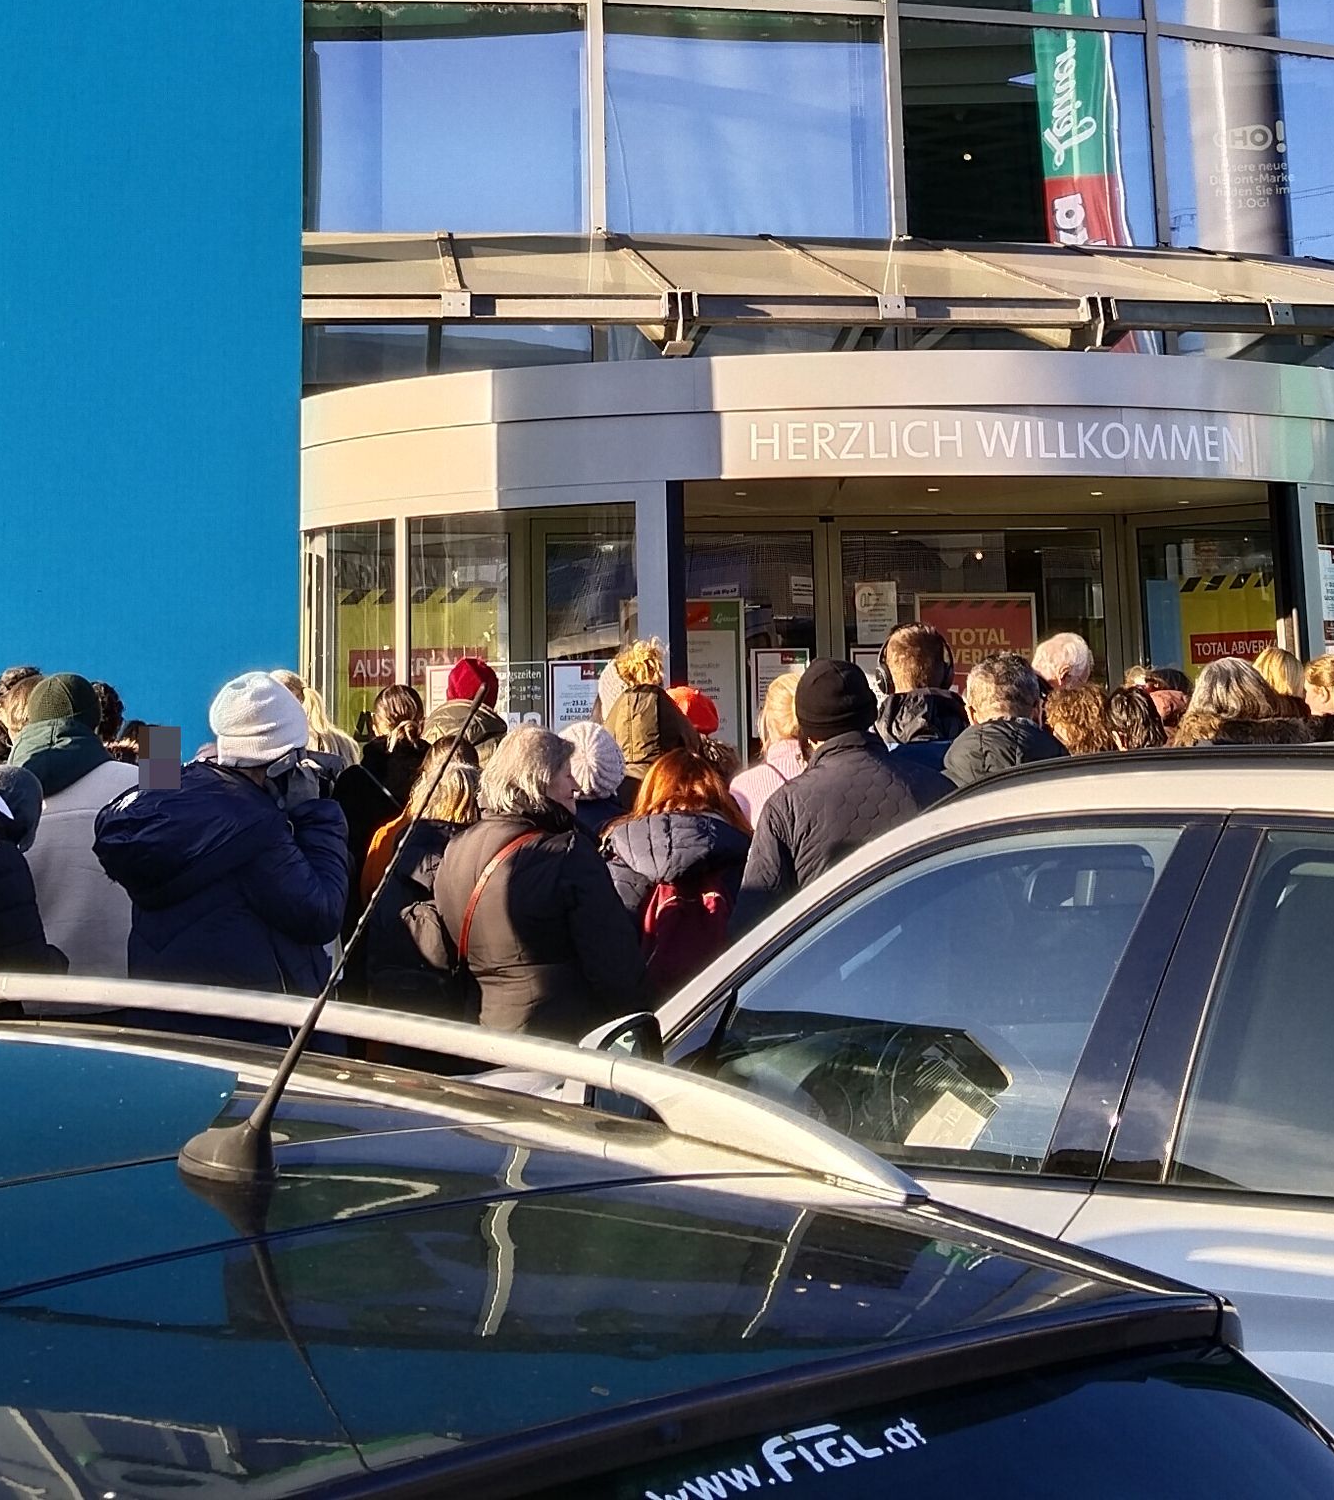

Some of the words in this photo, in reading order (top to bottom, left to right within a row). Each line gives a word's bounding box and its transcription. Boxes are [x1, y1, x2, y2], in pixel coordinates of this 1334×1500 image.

[750, 420, 963, 461] HERZLICH
[976, 420, 1245, 463] WILLKOMMEN
[947, 627, 1011, 646] TOTAL
[1195, 642, 1231, 656] TOTAL
